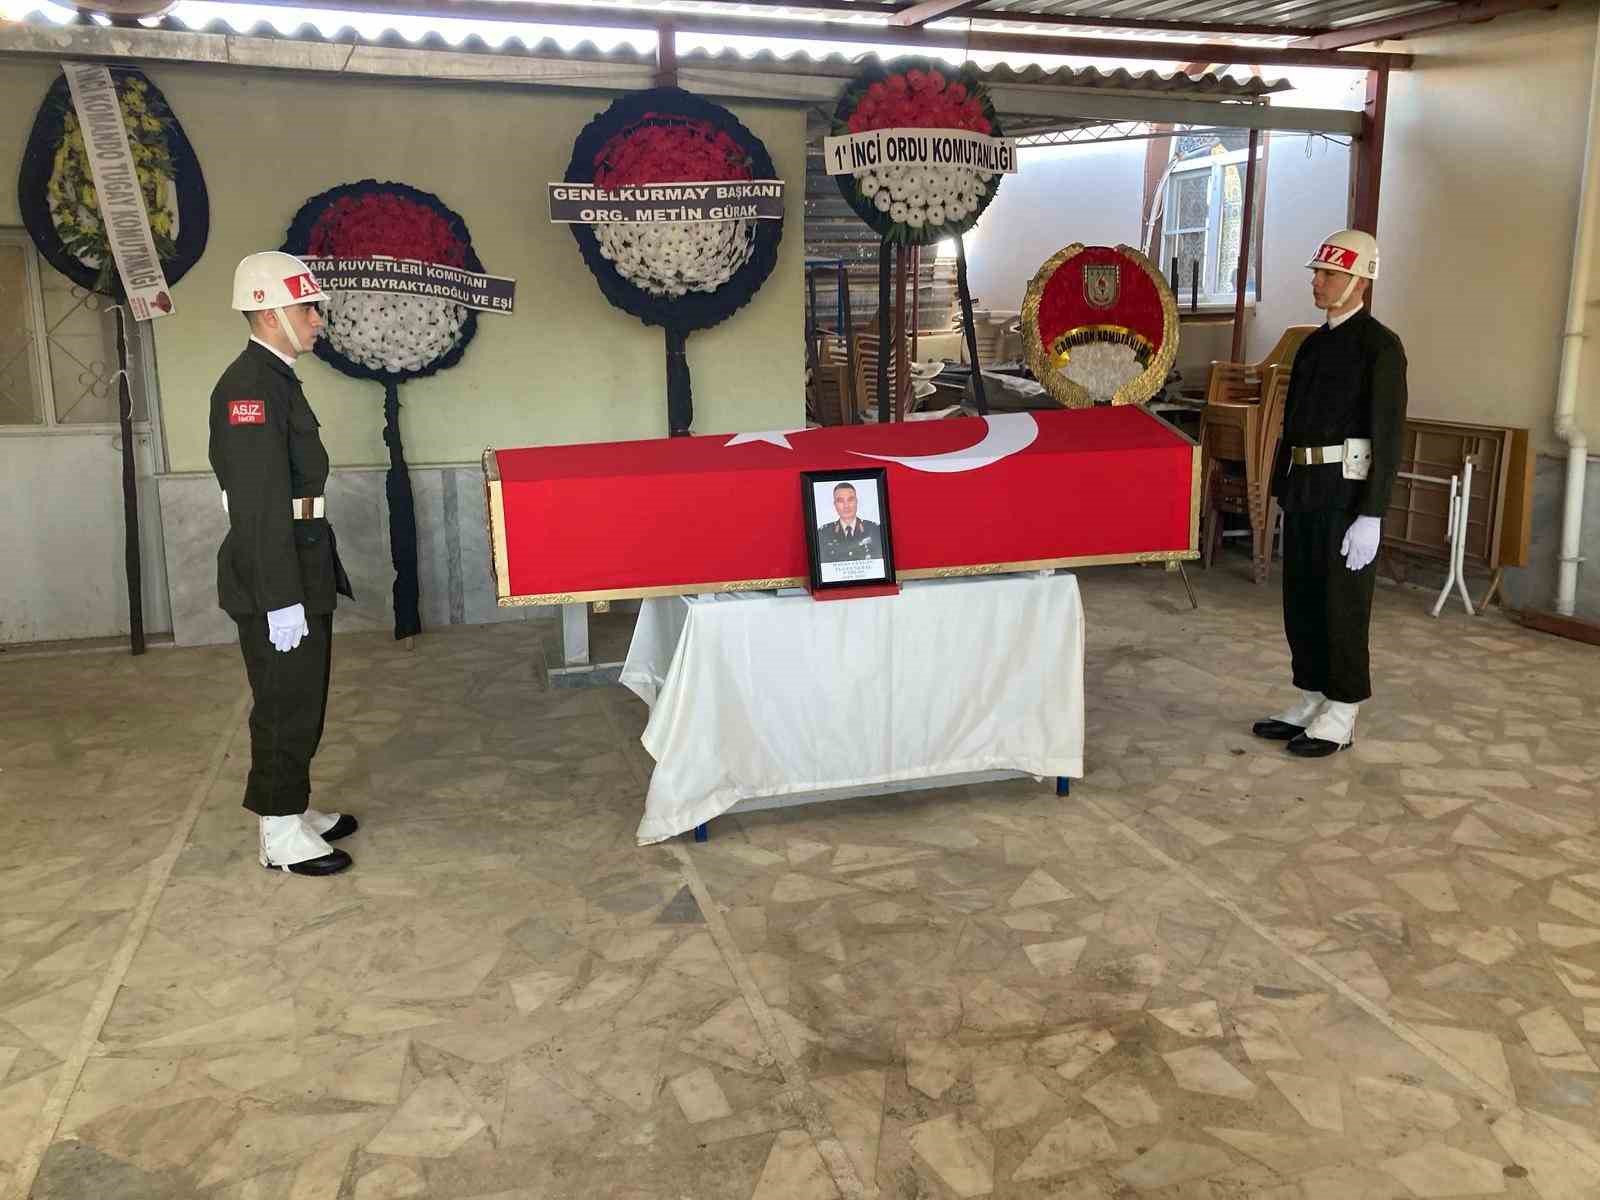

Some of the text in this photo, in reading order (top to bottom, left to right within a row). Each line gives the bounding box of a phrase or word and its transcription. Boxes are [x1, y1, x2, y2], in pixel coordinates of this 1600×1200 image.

[82, 94, 125, 159] KOMANDO
[850, 133, 882, 169] İNCİ
[887, 137, 928, 163] ORDU
[932, 137, 1013, 170] KOMUTANLIĞI
[101, 163, 136, 206] TUGAY
[553, 185, 782, 202] GENELKURMAY BAŞKANI
[580, 204, 757, 221] ORG. METİN GÜRAK
[338, 260, 423, 276] KUVVETLERİ
[426, 267, 488, 289] KOMUTANI
[316, 277, 513, 310] ELÇUK BAYRAKTAROĞLU VE EŞİ
